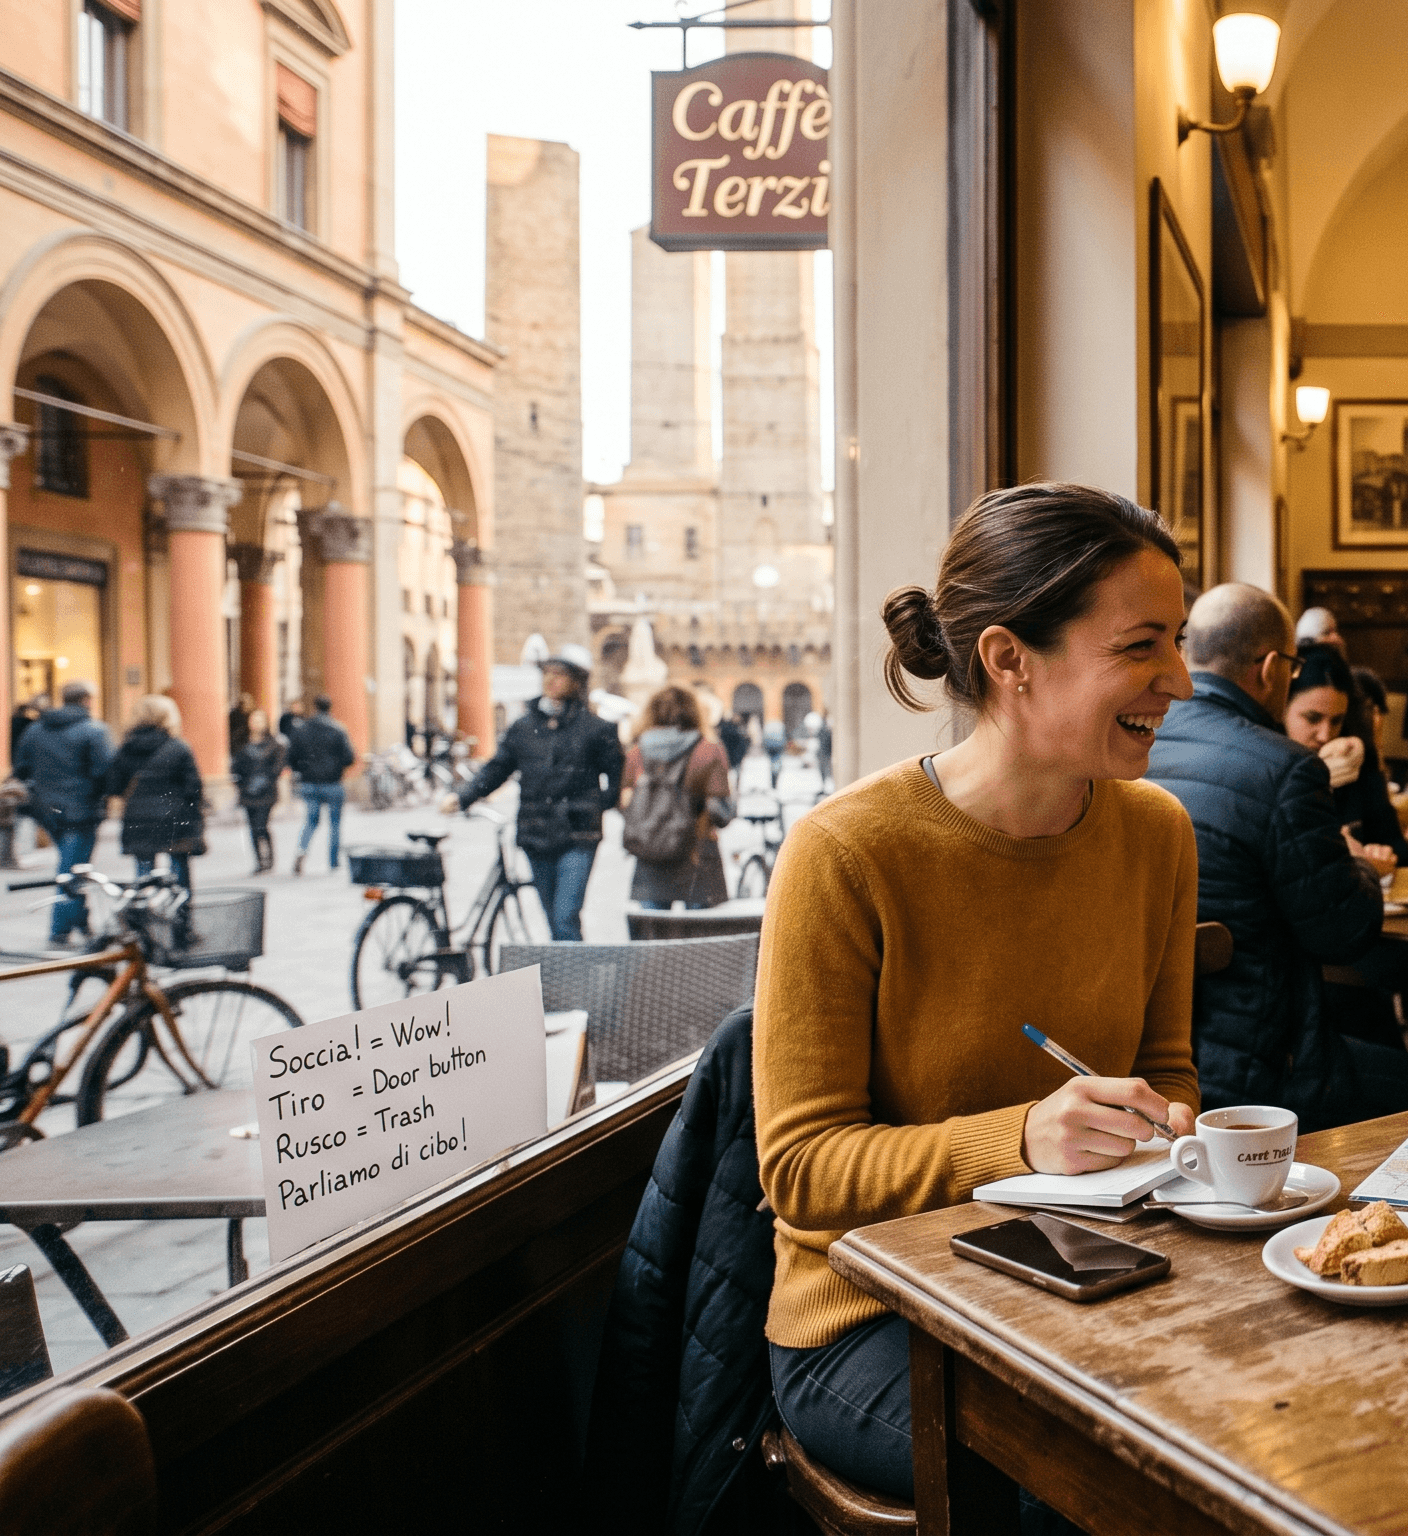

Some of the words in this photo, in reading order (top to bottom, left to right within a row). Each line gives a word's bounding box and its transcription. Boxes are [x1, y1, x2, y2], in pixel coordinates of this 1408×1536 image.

[672, 78, 832, 160] Caffè
[673, 154, 832, 219] Terzi
[269, 1024, 361, 1079] Soccia!
[370, 1037, 384, 1050] =
[391, 1000, 451, 1047] Wow!
[269, 1090, 325, 1120] Tiro
[352, 1084, 364, 1097] =
[373, 1066, 420, 1095] Door
[429, 1046, 486, 1078] button
[276, 1129, 347, 1163] Rusco
[357, 1125, 367, 1137] =
[374, 1095, 435, 1132] Trash
[278, 1163, 380, 1210] Parliamo
[392, 1144, 409, 1170] di
[419, 1117, 467, 1161] cibo!
